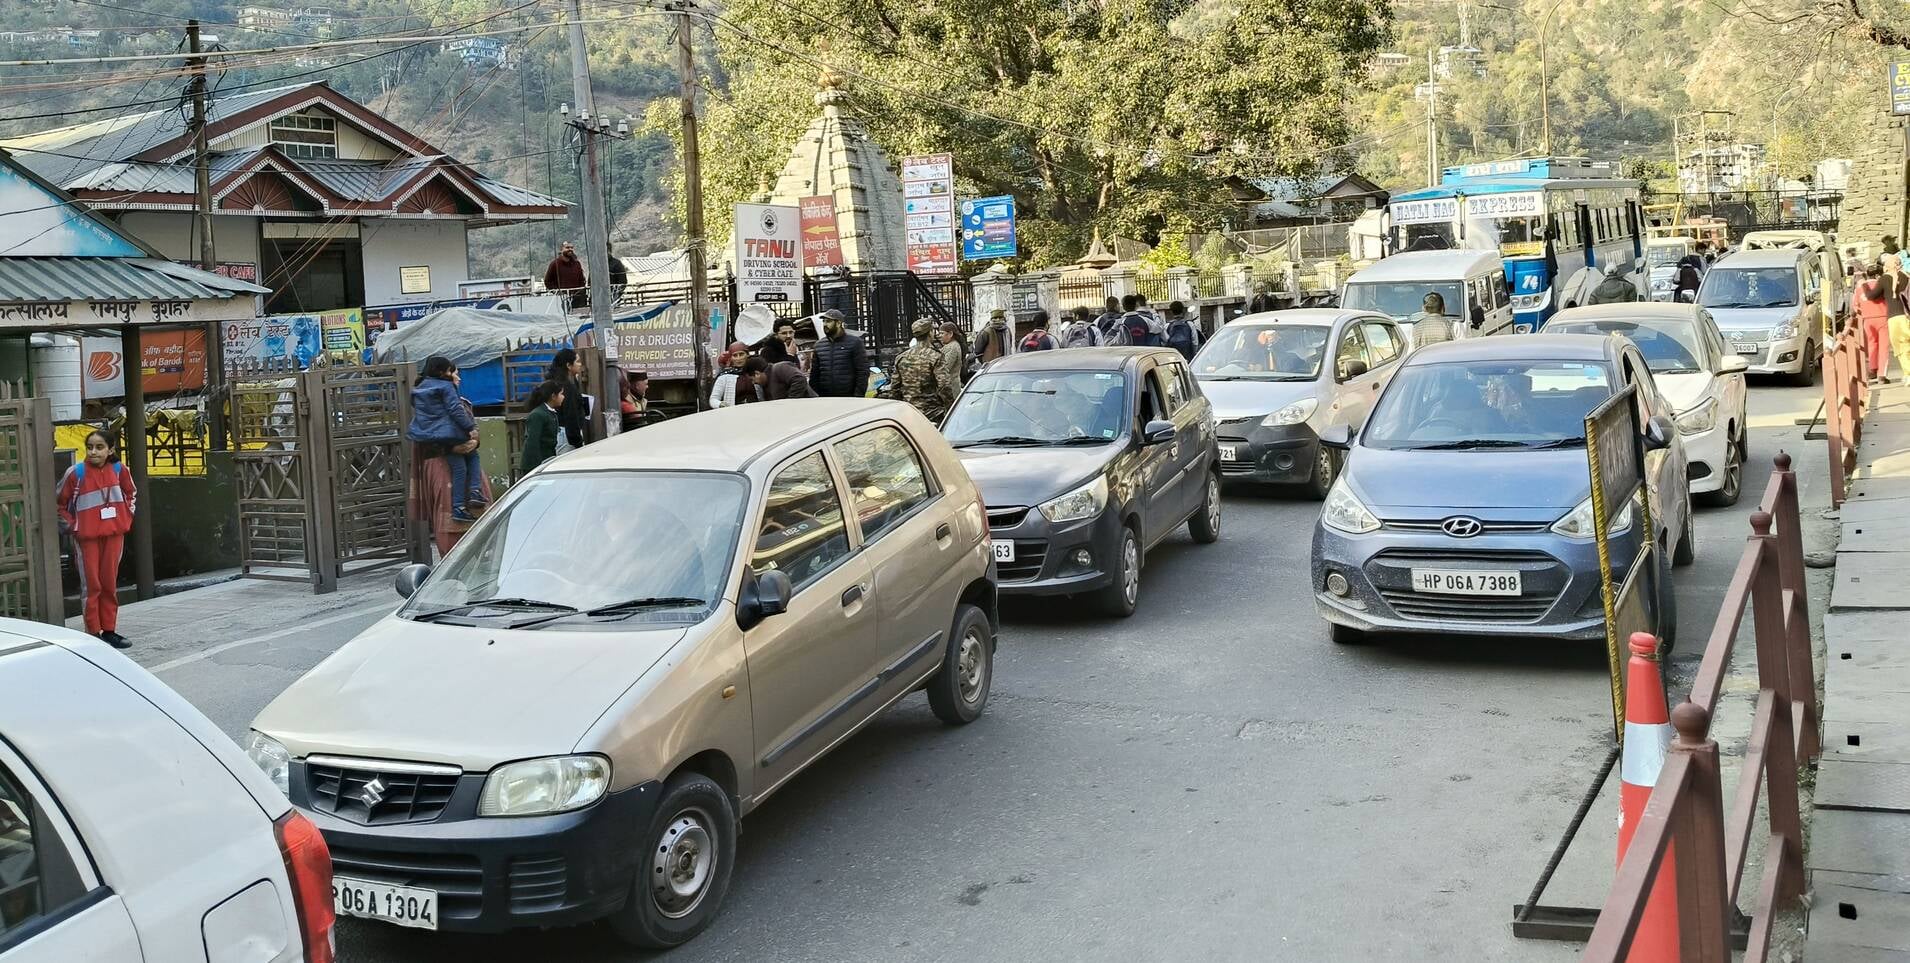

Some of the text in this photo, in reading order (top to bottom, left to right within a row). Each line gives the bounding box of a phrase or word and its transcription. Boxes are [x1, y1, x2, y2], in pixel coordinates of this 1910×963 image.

[1469, 195, 1536, 215] EXPRESS
[744, 238, 795, 258] TANU
[743, 260, 797, 268] DRIVING SCHOOL
[230, 265, 255, 279] CAFE
[755, 269, 775, 277] CYBER
[777, 269, 793, 277] CAFE
[89, 300, 140, 322] रामपुर
[151, 300, 193, 321] बुशहर
[639, 335, 646, 346] &
[648, 333, 695, 346] DRUGGIS
[149, 358, 157, 367] of
[996, 544, 1010, 558] 63
[1423, 574, 1517, 591] HP 06A 7388
[342, 886, 377, 915] 06A
[385, 892, 432, 923] 1304
